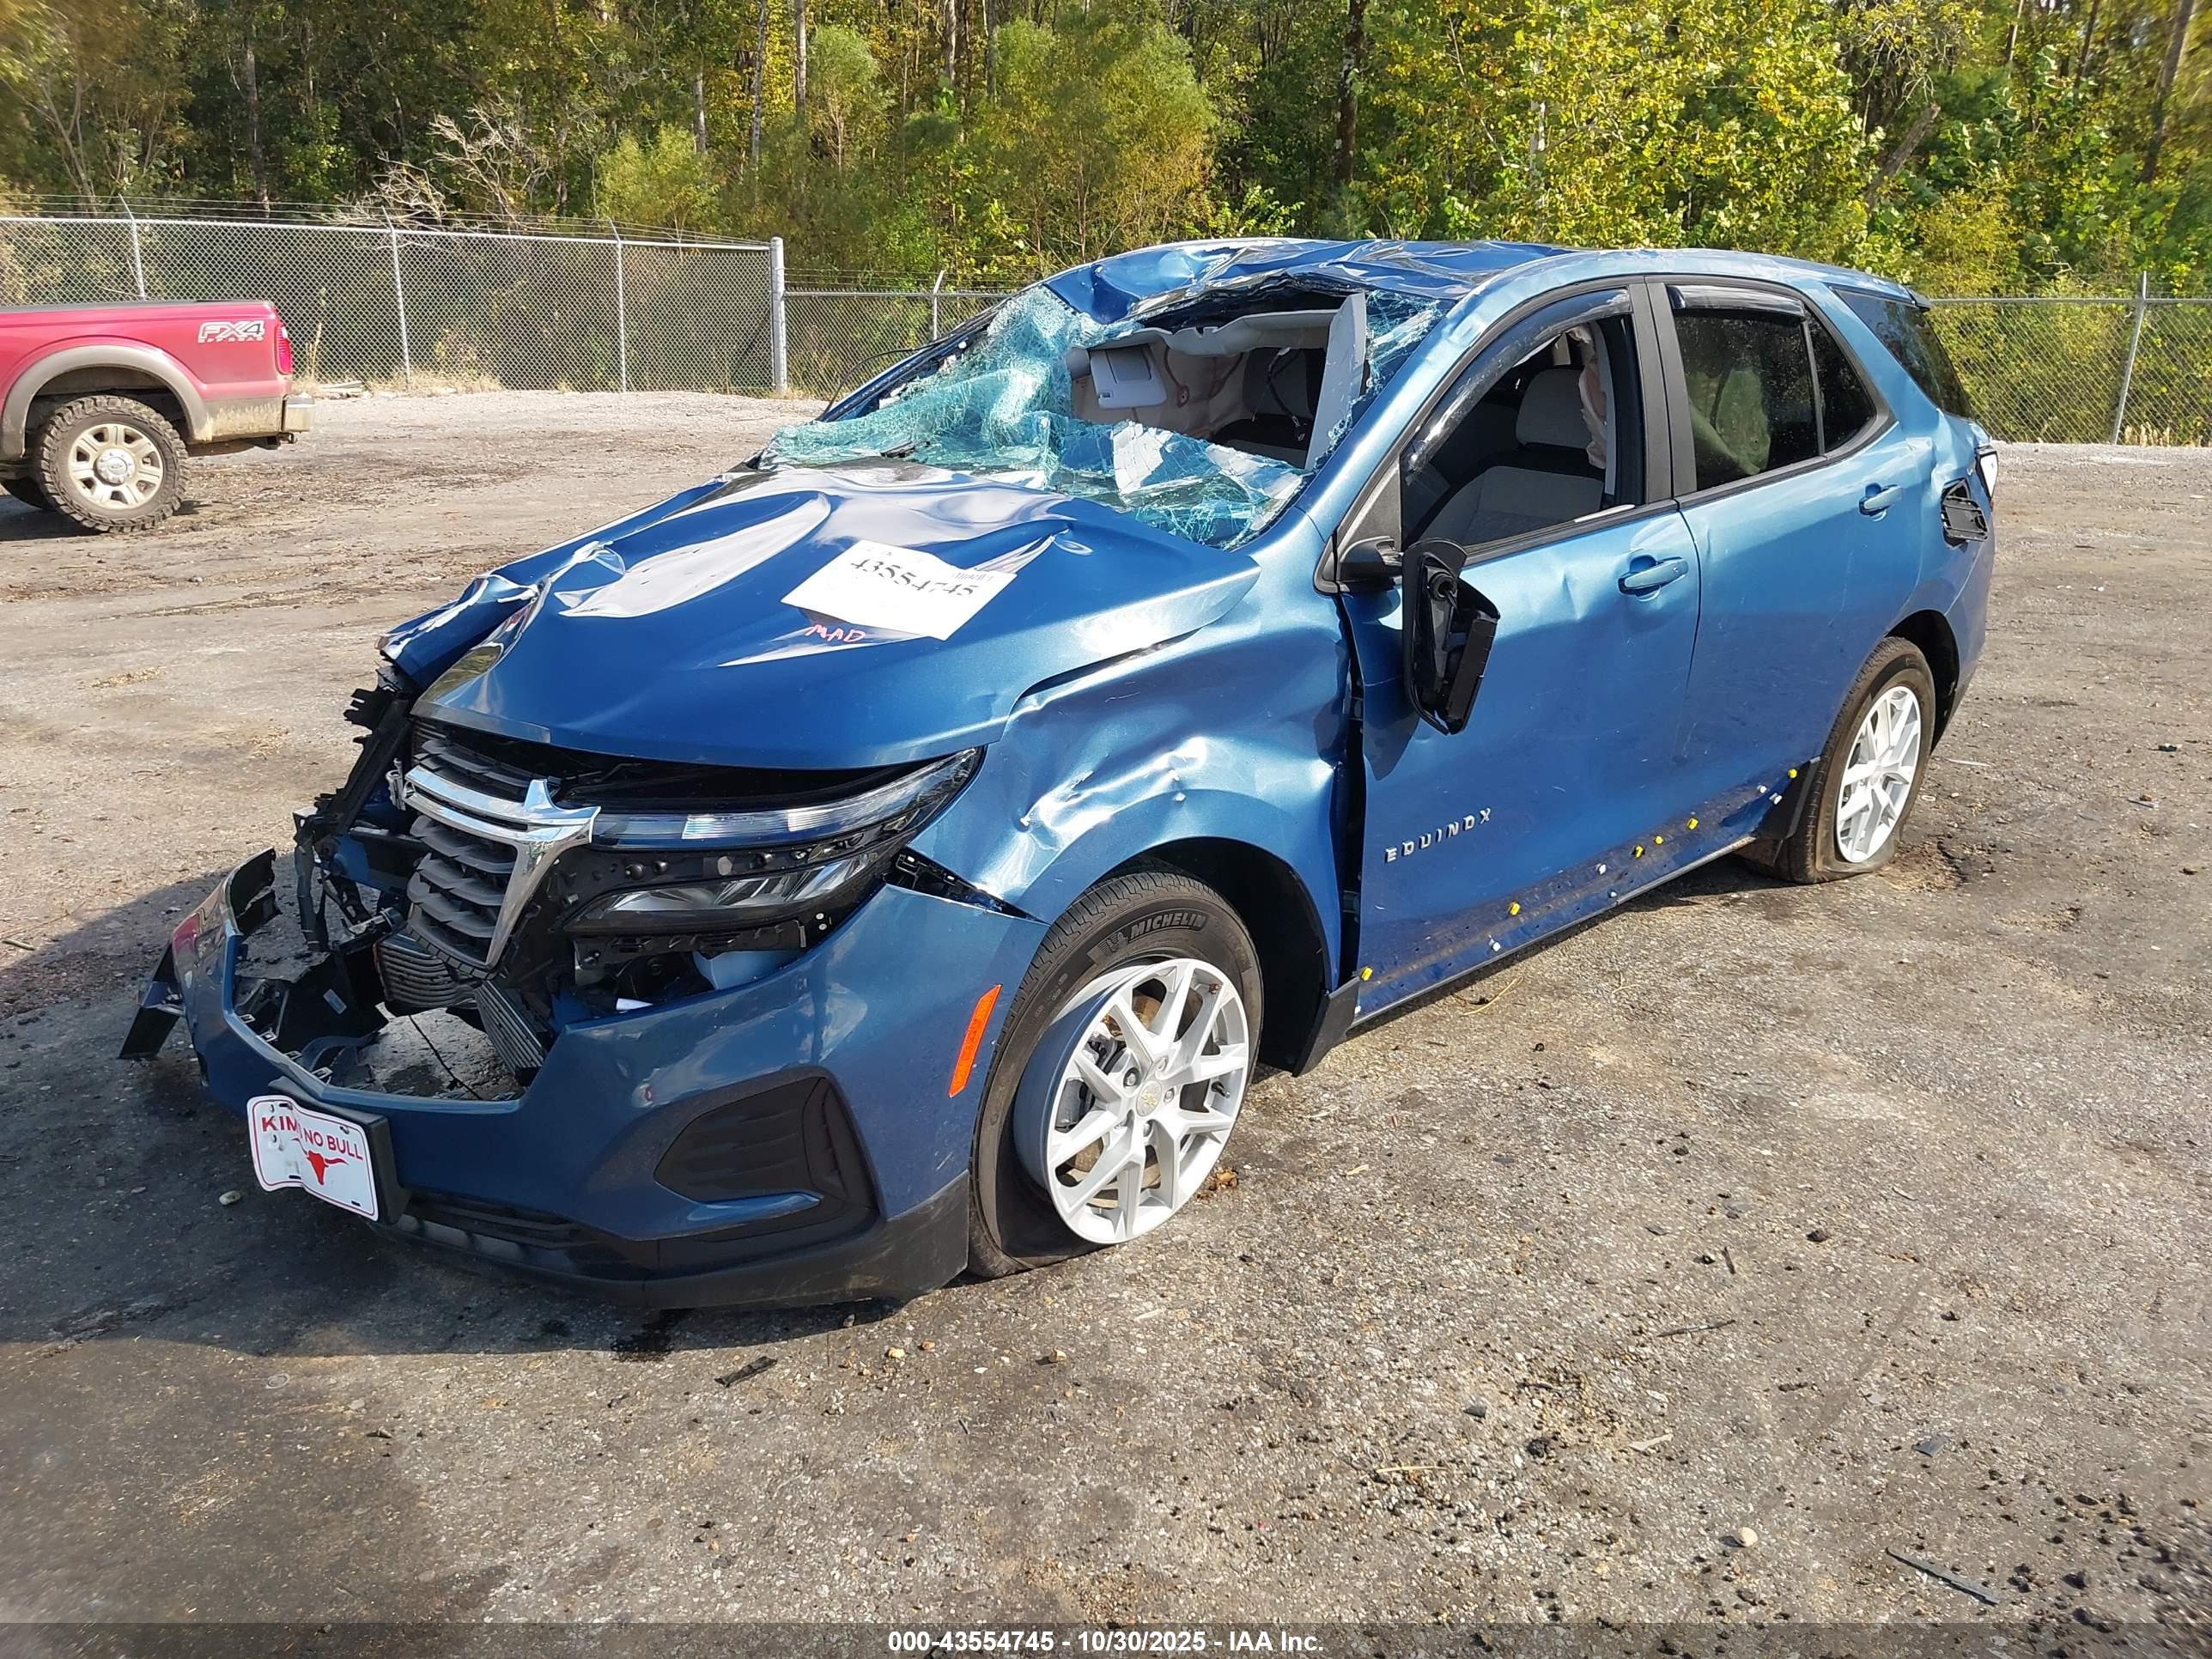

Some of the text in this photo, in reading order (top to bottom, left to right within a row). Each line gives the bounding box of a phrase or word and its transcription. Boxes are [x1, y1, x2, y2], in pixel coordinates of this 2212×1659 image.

[198, 320, 265, 339] FX4
[805, 624, 866, 642] MAD
[1130, 912, 1206, 939] MICHELIN
[303, 1127, 324, 1147] NO
[326, 1135, 364, 1161] BULL
